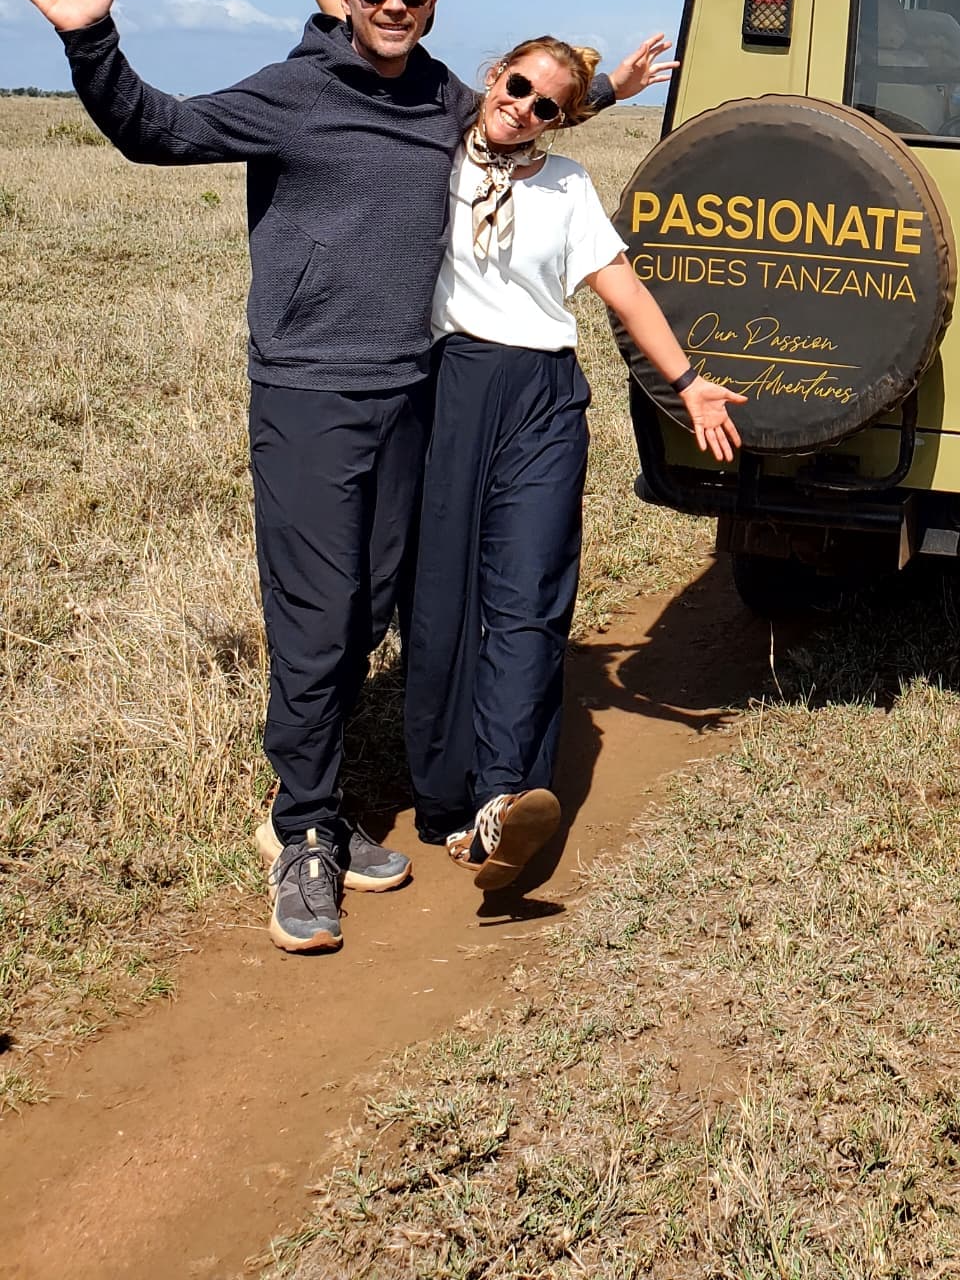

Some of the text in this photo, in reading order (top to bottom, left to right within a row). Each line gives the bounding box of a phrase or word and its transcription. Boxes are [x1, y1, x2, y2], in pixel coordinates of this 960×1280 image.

[631, 191, 925, 255] PASSIONATE
[632, 254, 918, 304] GUIDES TANZANIA
[687, 312, 839, 352] Our Passion
[735, 363, 858, 405] Adventures
